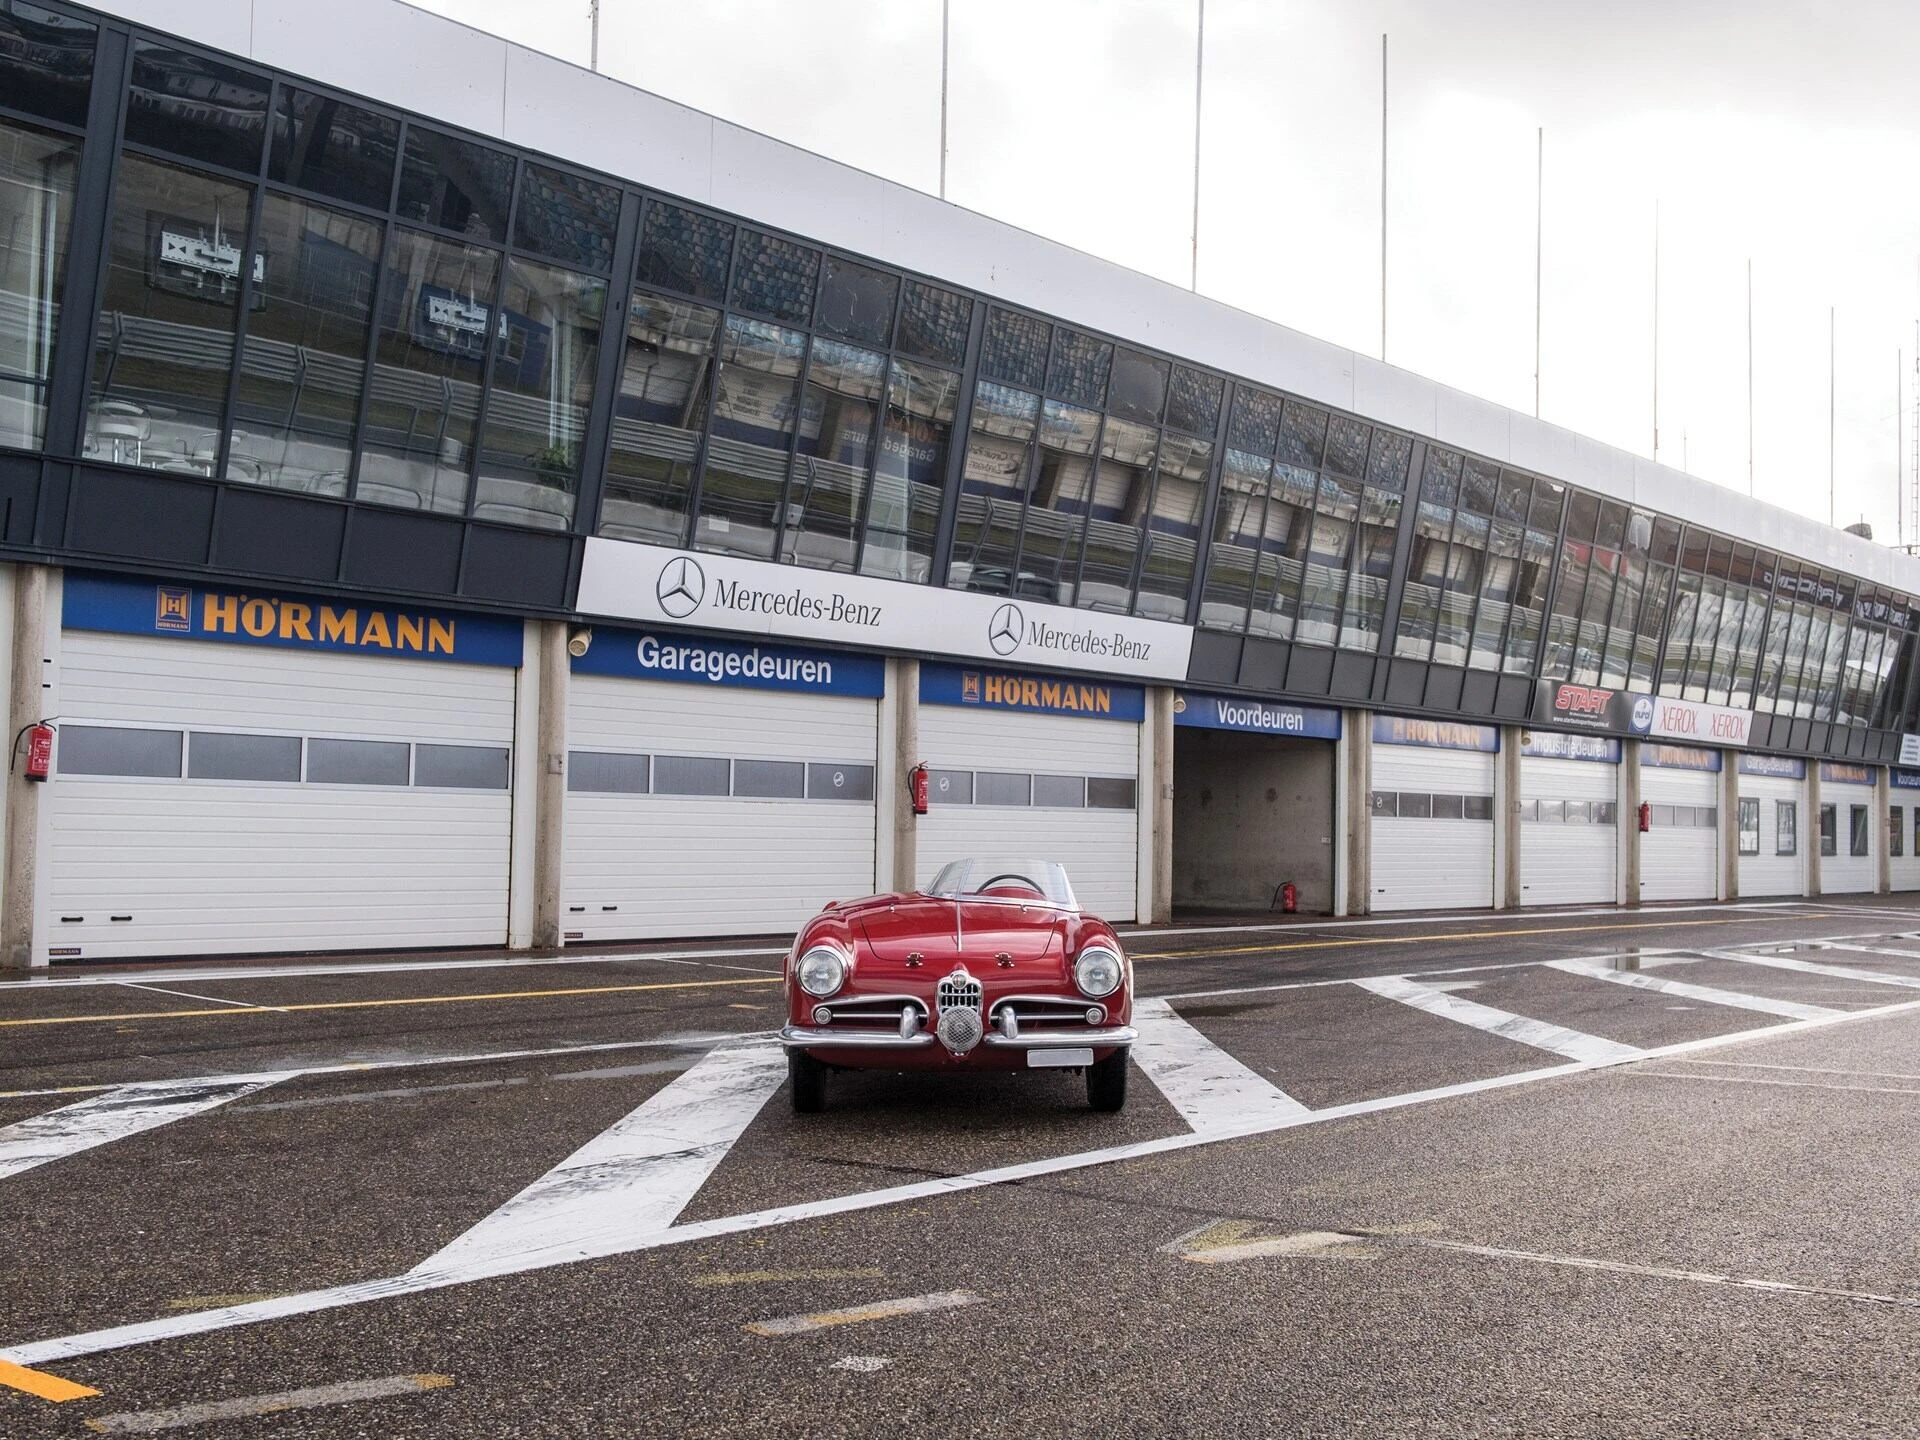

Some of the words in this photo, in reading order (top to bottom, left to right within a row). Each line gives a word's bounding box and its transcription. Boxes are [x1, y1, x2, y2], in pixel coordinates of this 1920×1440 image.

[712, 578, 882, 627] Mercedes-Benz
[203, 594, 455, 655] HÖRMANN
[1027, 621, 1151, 661] Mercedes-Benz
[637, 636, 832, 684] Garagedeuren
[985, 675, 1111, 713] HÖRMANN
[1555, 684, 1614, 714] START
[1217, 700, 1304, 731] Voordeuren
[1660, 706, 1698, 734] XEROX
[1710, 713, 1747, 740] XEROX
